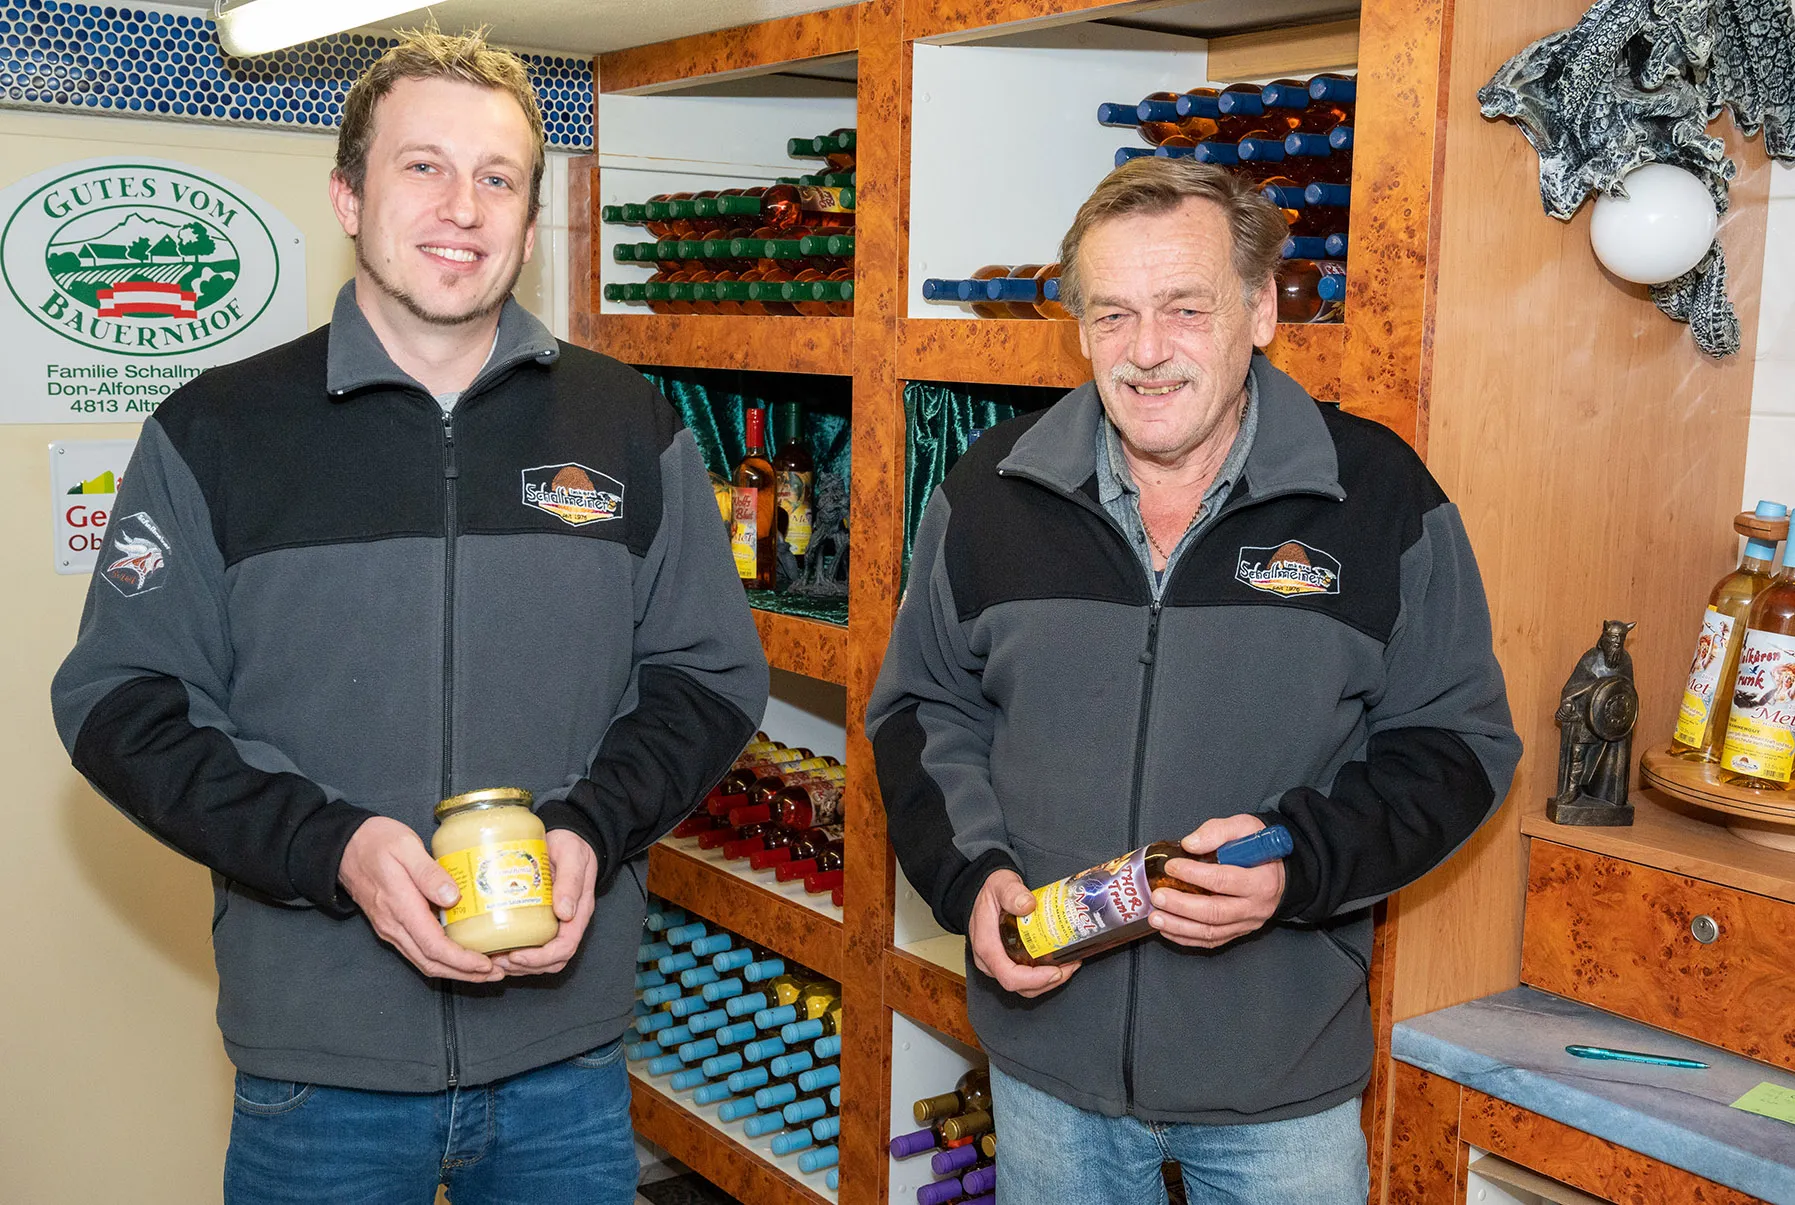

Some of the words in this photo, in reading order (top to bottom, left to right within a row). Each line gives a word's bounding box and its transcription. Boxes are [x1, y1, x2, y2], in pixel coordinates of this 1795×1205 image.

[43, 176, 157, 219] GUTES
[170, 181, 239, 228] VOM
[38, 288, 244, 351] BAUERNHOF
[47, 363, 118, 379] Familie
[125, 363, 216, 379] Schallm
[47, 381, 183, 396] Don-Alfonso-
[71, 399, 119, 413] 4813
[66, 505, 112, 528] Ge
[68, 533, 102, 552] Ob
[1737, 669, 1765, 690] runk
[1121, 865, 1142, 913] THOR
[1108, 879, 1138, 923] Trunk
